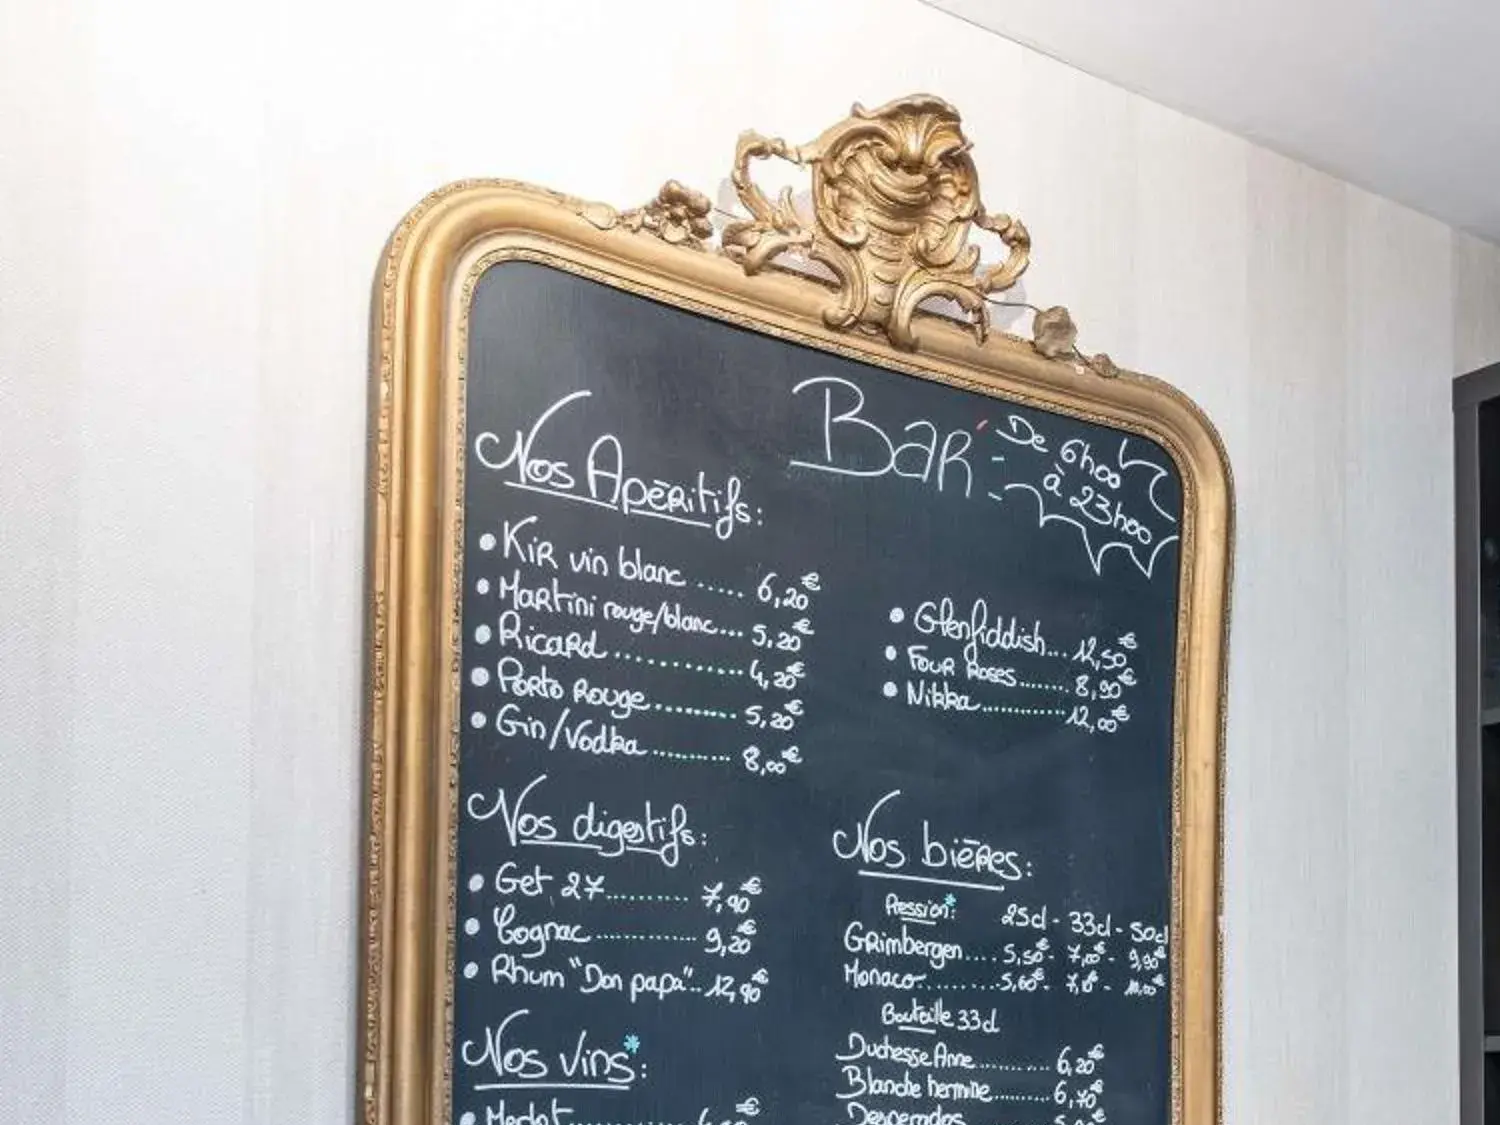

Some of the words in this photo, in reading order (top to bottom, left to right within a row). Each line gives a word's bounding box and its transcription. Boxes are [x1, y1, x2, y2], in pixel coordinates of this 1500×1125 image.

[475, 391, 592, 488] Nos
[996, 415, 1048, 453] De
[1060, 440, 1121, 489] 6h00
[1043, 463, 1066, 496] à
[1069, 485, 1152, 545] 23h00
[569, 547, 607, 575] vin
[619, 546, 686, 586] blanc
[757, 572, 821, 611] 6,20€
[500, 570, 596, 617] Martini
[603, 602, 718, 634] rouge/blanc
[752, 619, 815, 651] 5,20€
[500, 611, 607, 659] Ricard
[750, 660, 806, 690] 4,20€
[1071, 632, 1138, 671] 12,50€
[498, 656, 564, 699] Porto
[745, 700, 803, 730] 5,20€
[906, 680, 981, 711] Nikka
[496, 703, 649, 757] Gin/Vodka
[743, 746, 802, 775] 8,00€
[468, 774, 557, 845] Nos
[832, 790, 905, 868] Nos
[495, 860, 553, 895] Get
[561, 872, 606, 900] 27
[701, 876, 763, 914] 7,90€
[494, 903, 591, 958] Cognac
[703, 918, 757, 957] 9,20€
[844, 921, 963, 969] Grimbergen
[1003, 937, 1050, 967] 5,50€
[1000, 903, 1047, 931] 25cl
[1068, 911, 1111, 937] 33cl
[1129, 921, 1169, 945] 50cl
[491, 953, 565, 989] Rhum
[704, 967, 769, 1004] 12,90€
[844, 963, 927, 989] Monaco
[461, 1009, 548, 1078] Nos
[957, 1008, 1000, 1034] 33cl
[835, 1031, 932, 1068] Duchesse
[933, 1042, 976, 1070] Anne
[1056, 1044, 1104, 1077] 6,20€
[835, 1065, 922, 1099] Blanche
